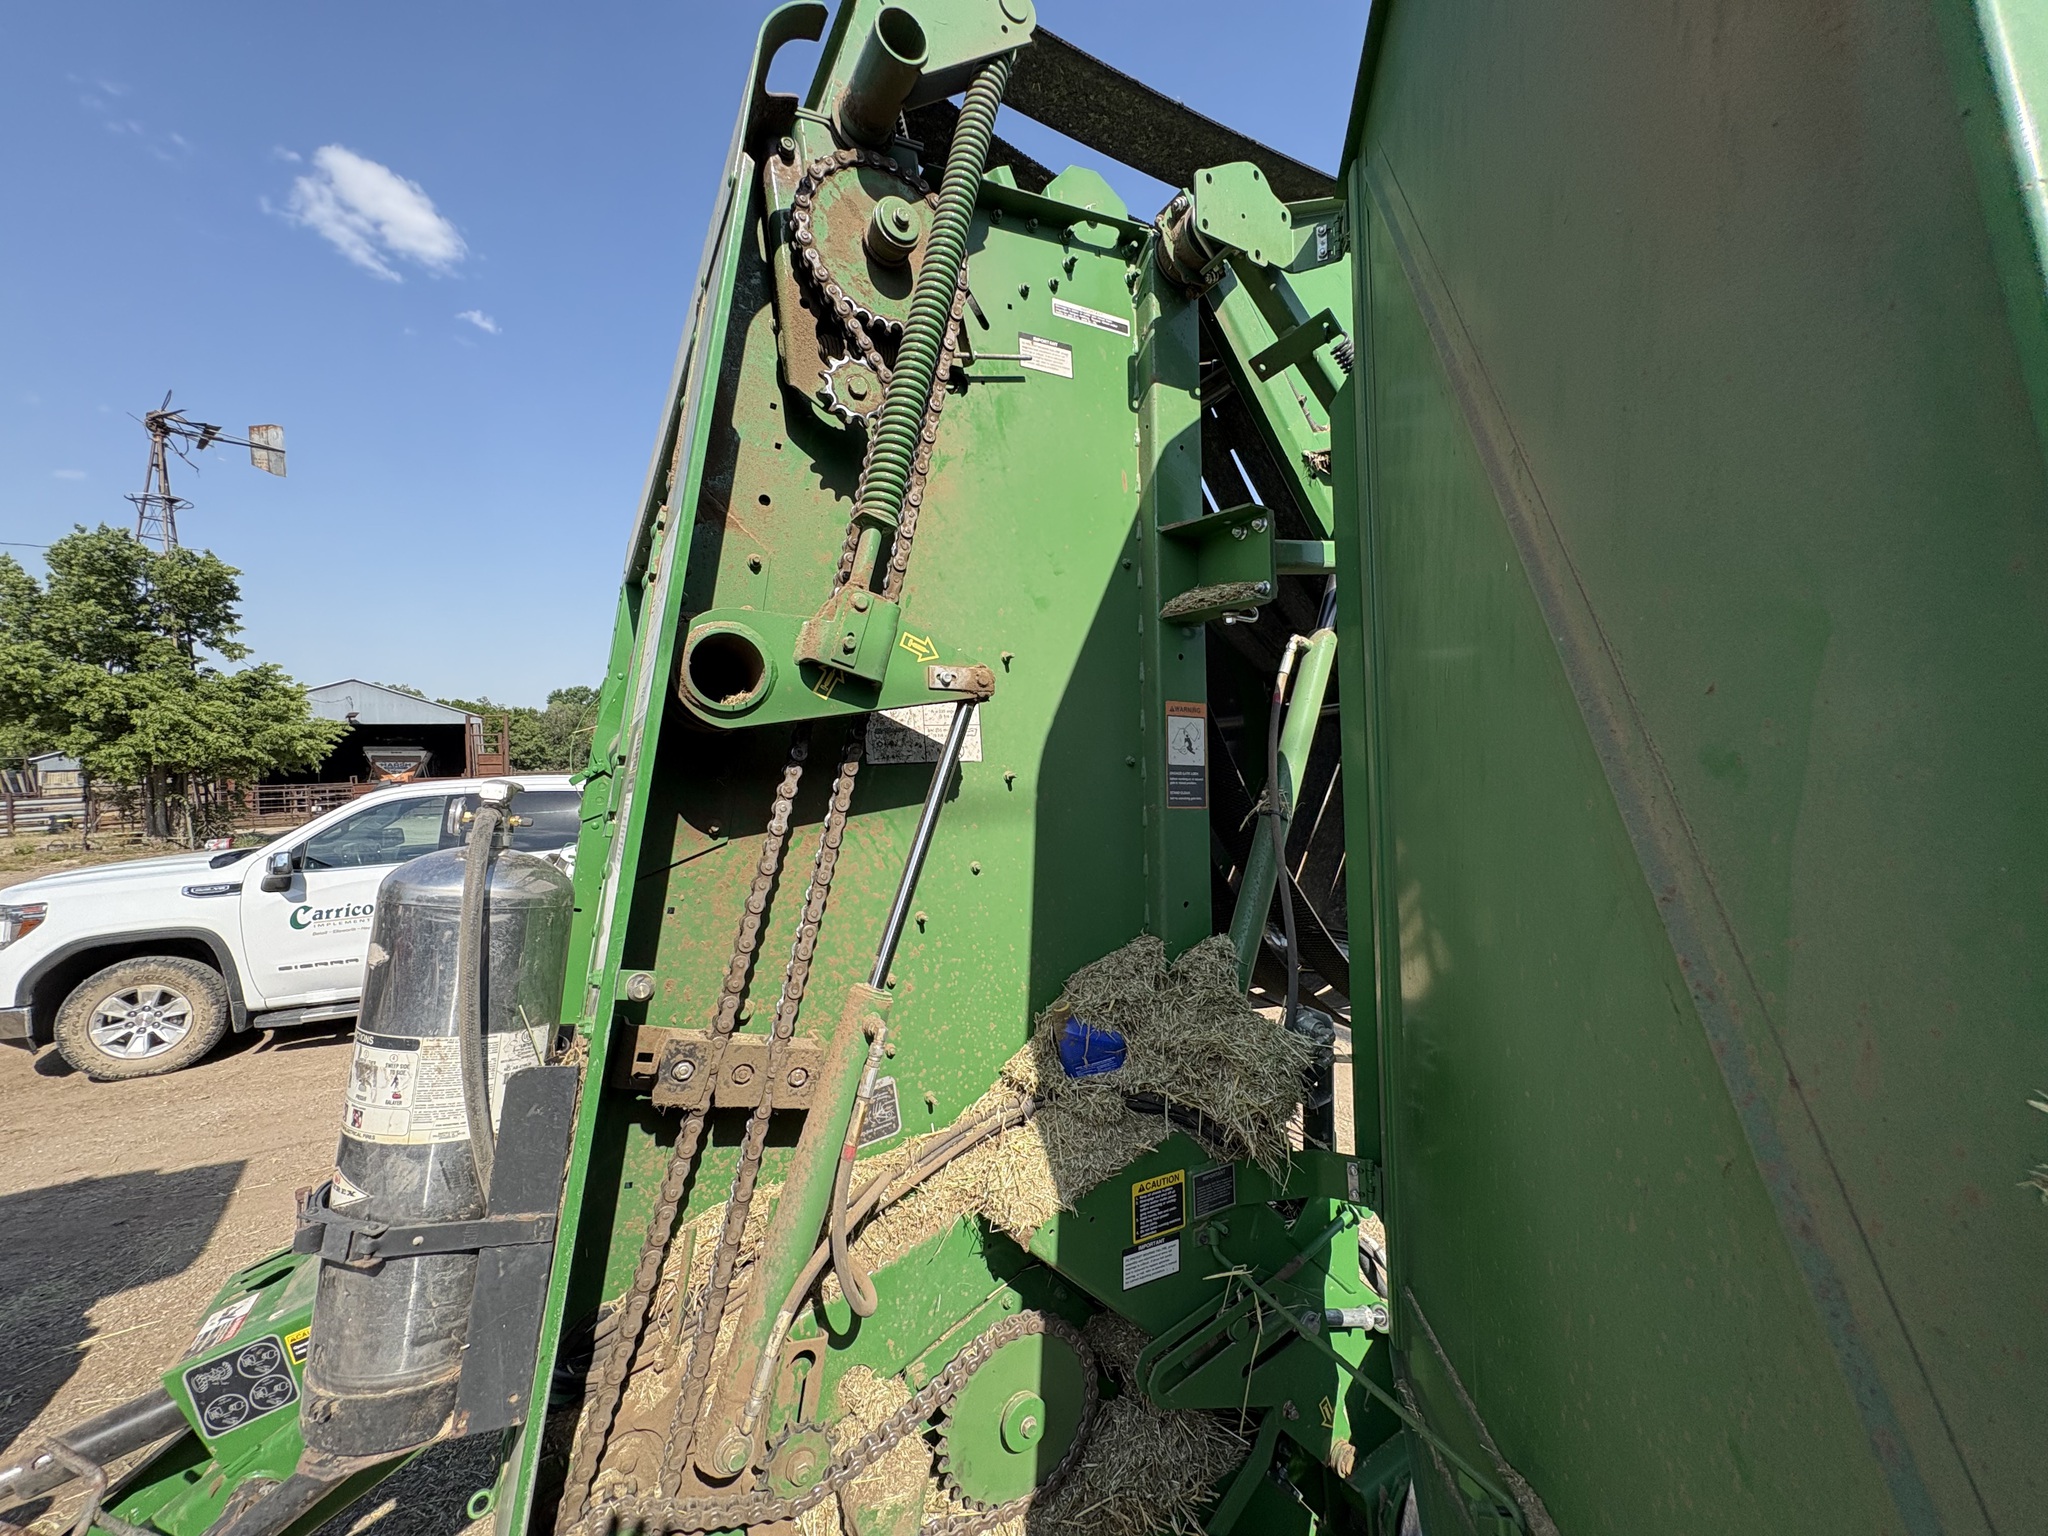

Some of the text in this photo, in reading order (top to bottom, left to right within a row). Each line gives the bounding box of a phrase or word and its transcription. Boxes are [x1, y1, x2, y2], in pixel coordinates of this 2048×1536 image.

[1174, 705, 1201, 713] WARNING
[289, 903, 375, 930] Carrico
[313, 918, 371, 929] IMPLEMENT
[1145, 1173, 1180, 1191] CAUTION
[1138, 1237, 1166, 1251] IMPORTANT
